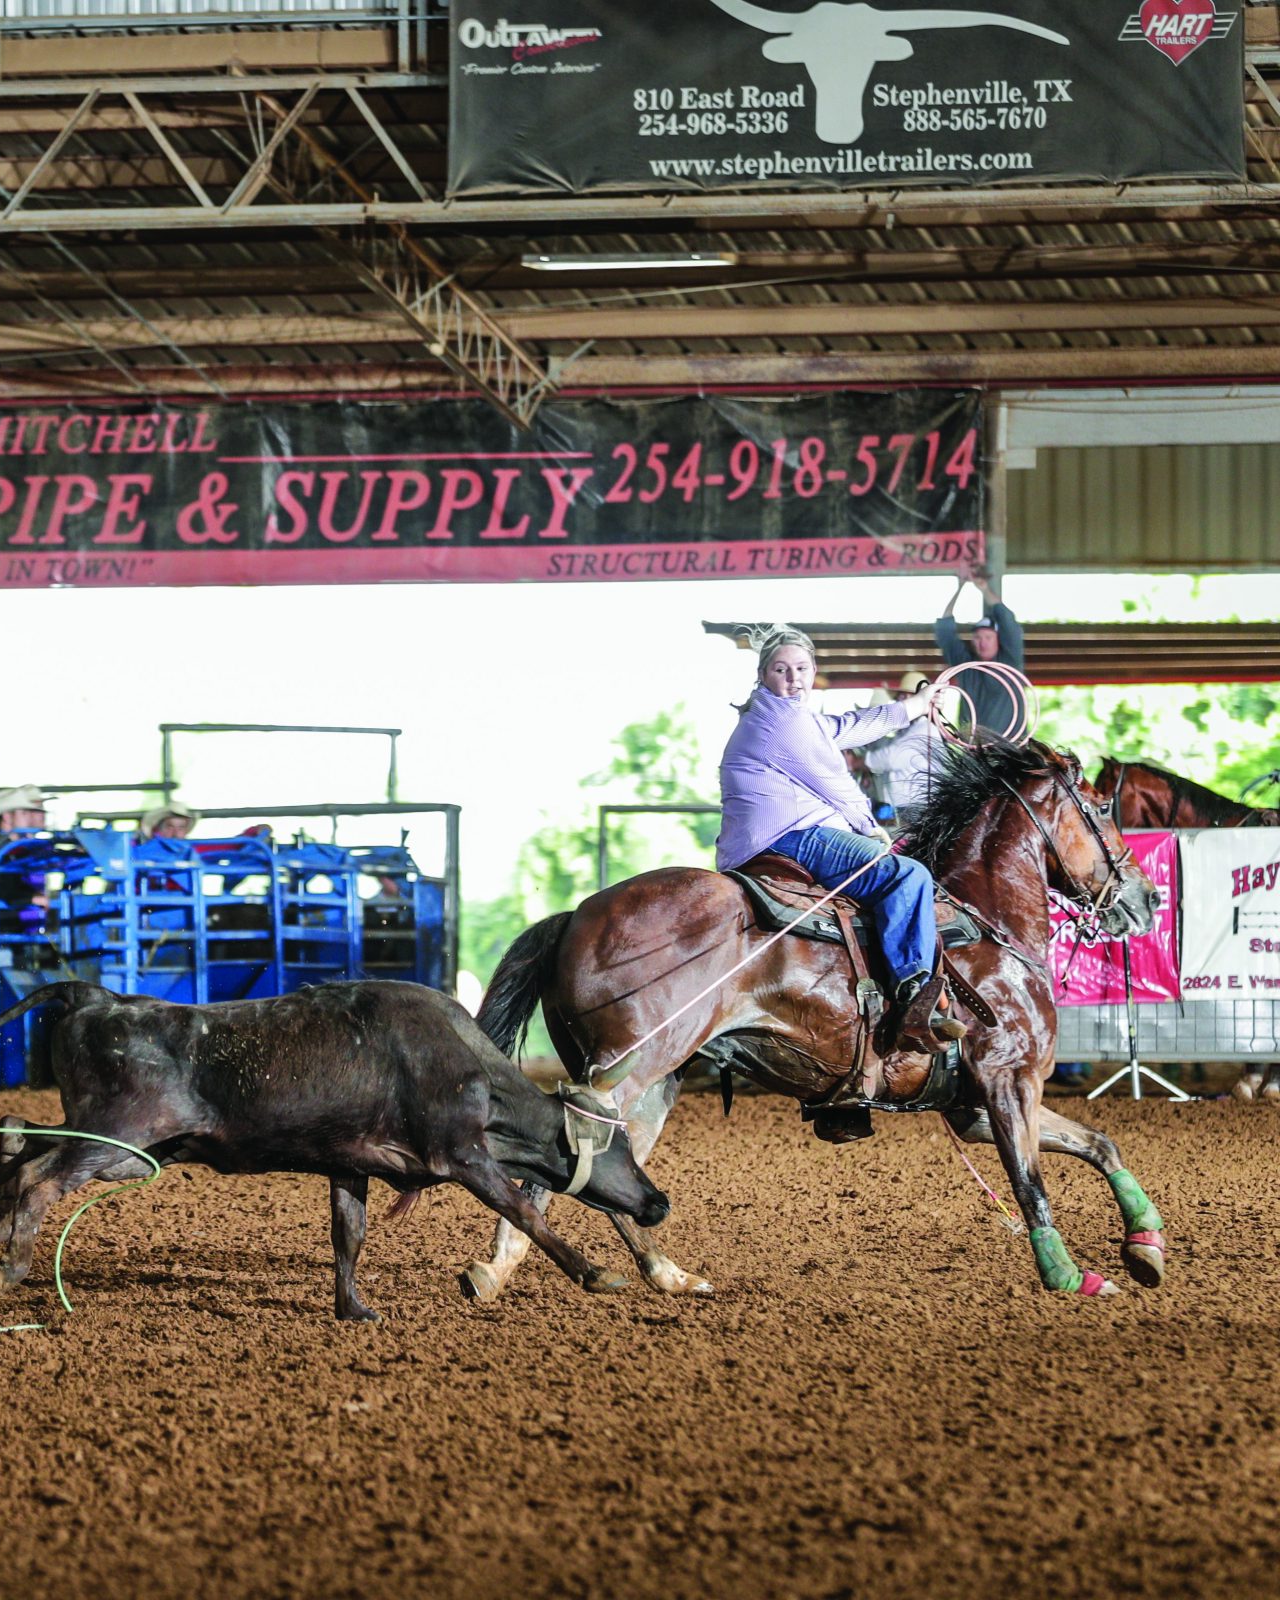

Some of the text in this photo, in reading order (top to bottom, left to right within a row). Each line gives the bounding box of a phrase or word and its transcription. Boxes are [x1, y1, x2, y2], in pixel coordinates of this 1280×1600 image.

[1145, 13, 1214, 37] HART
[1155, 36, 1197, 45] TRAILERS
[633, 84, 806, 111] 810 East Road
[873, 79, 1074, 110] Stephenville, TX
[638, 111, 789, 136] 254-968-5336
[903, 106, 1047, 132] 888-565-7670
[648, 147, 1034, 180] www.stephenvilletrailers.com
[604, 428, 978, 503] 254-918-5714
[175, 472, 239, 544] &
[264, 467, 594, 543] SUPPLY
[5, 559, 36, 582] IN
[547, 538, 980, 577] STRUCTURAL TUBING & RODS
[1183, 975, 1222, 990] 2824
